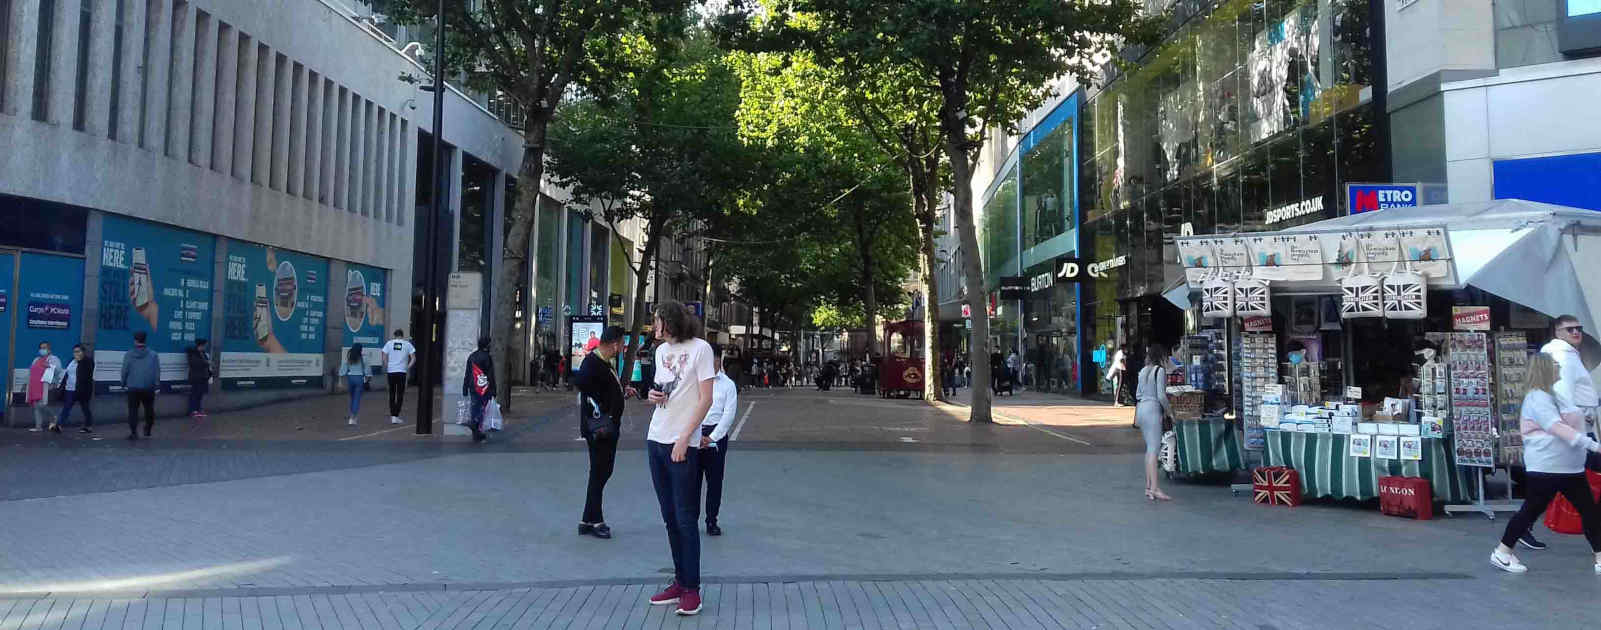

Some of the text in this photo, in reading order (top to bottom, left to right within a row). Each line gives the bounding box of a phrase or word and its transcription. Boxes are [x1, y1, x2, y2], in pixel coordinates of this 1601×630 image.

[1265, 196, 1324, 224] JDSPORTS.CO.UK
[1356, 190, 1413, 212] METRO
[1058, 262, 1079, 278] JD
[1031, 271, 1053, 292] BURTON
